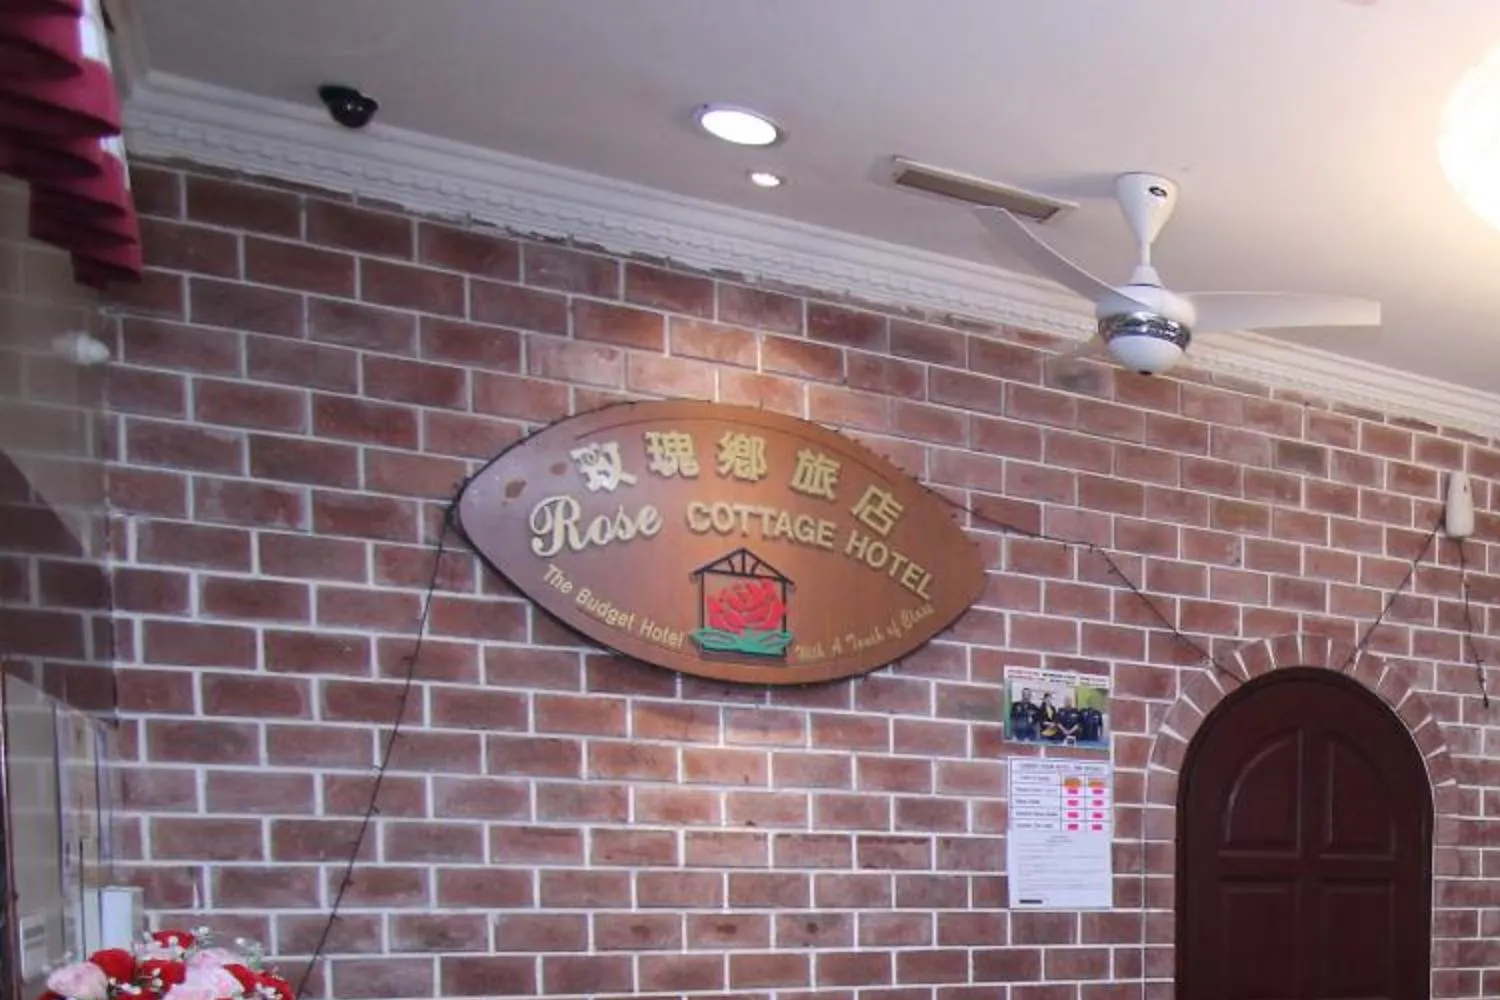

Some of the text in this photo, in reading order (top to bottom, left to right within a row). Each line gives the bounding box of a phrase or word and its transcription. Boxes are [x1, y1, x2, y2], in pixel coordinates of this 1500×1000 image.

[570, 430, 903, 537] 玫瑰鄉旅店
[529, 495, 934, 600] Rose COTTAGE HOTEL
[544, 564, 685, 649] The Budget Hotel
